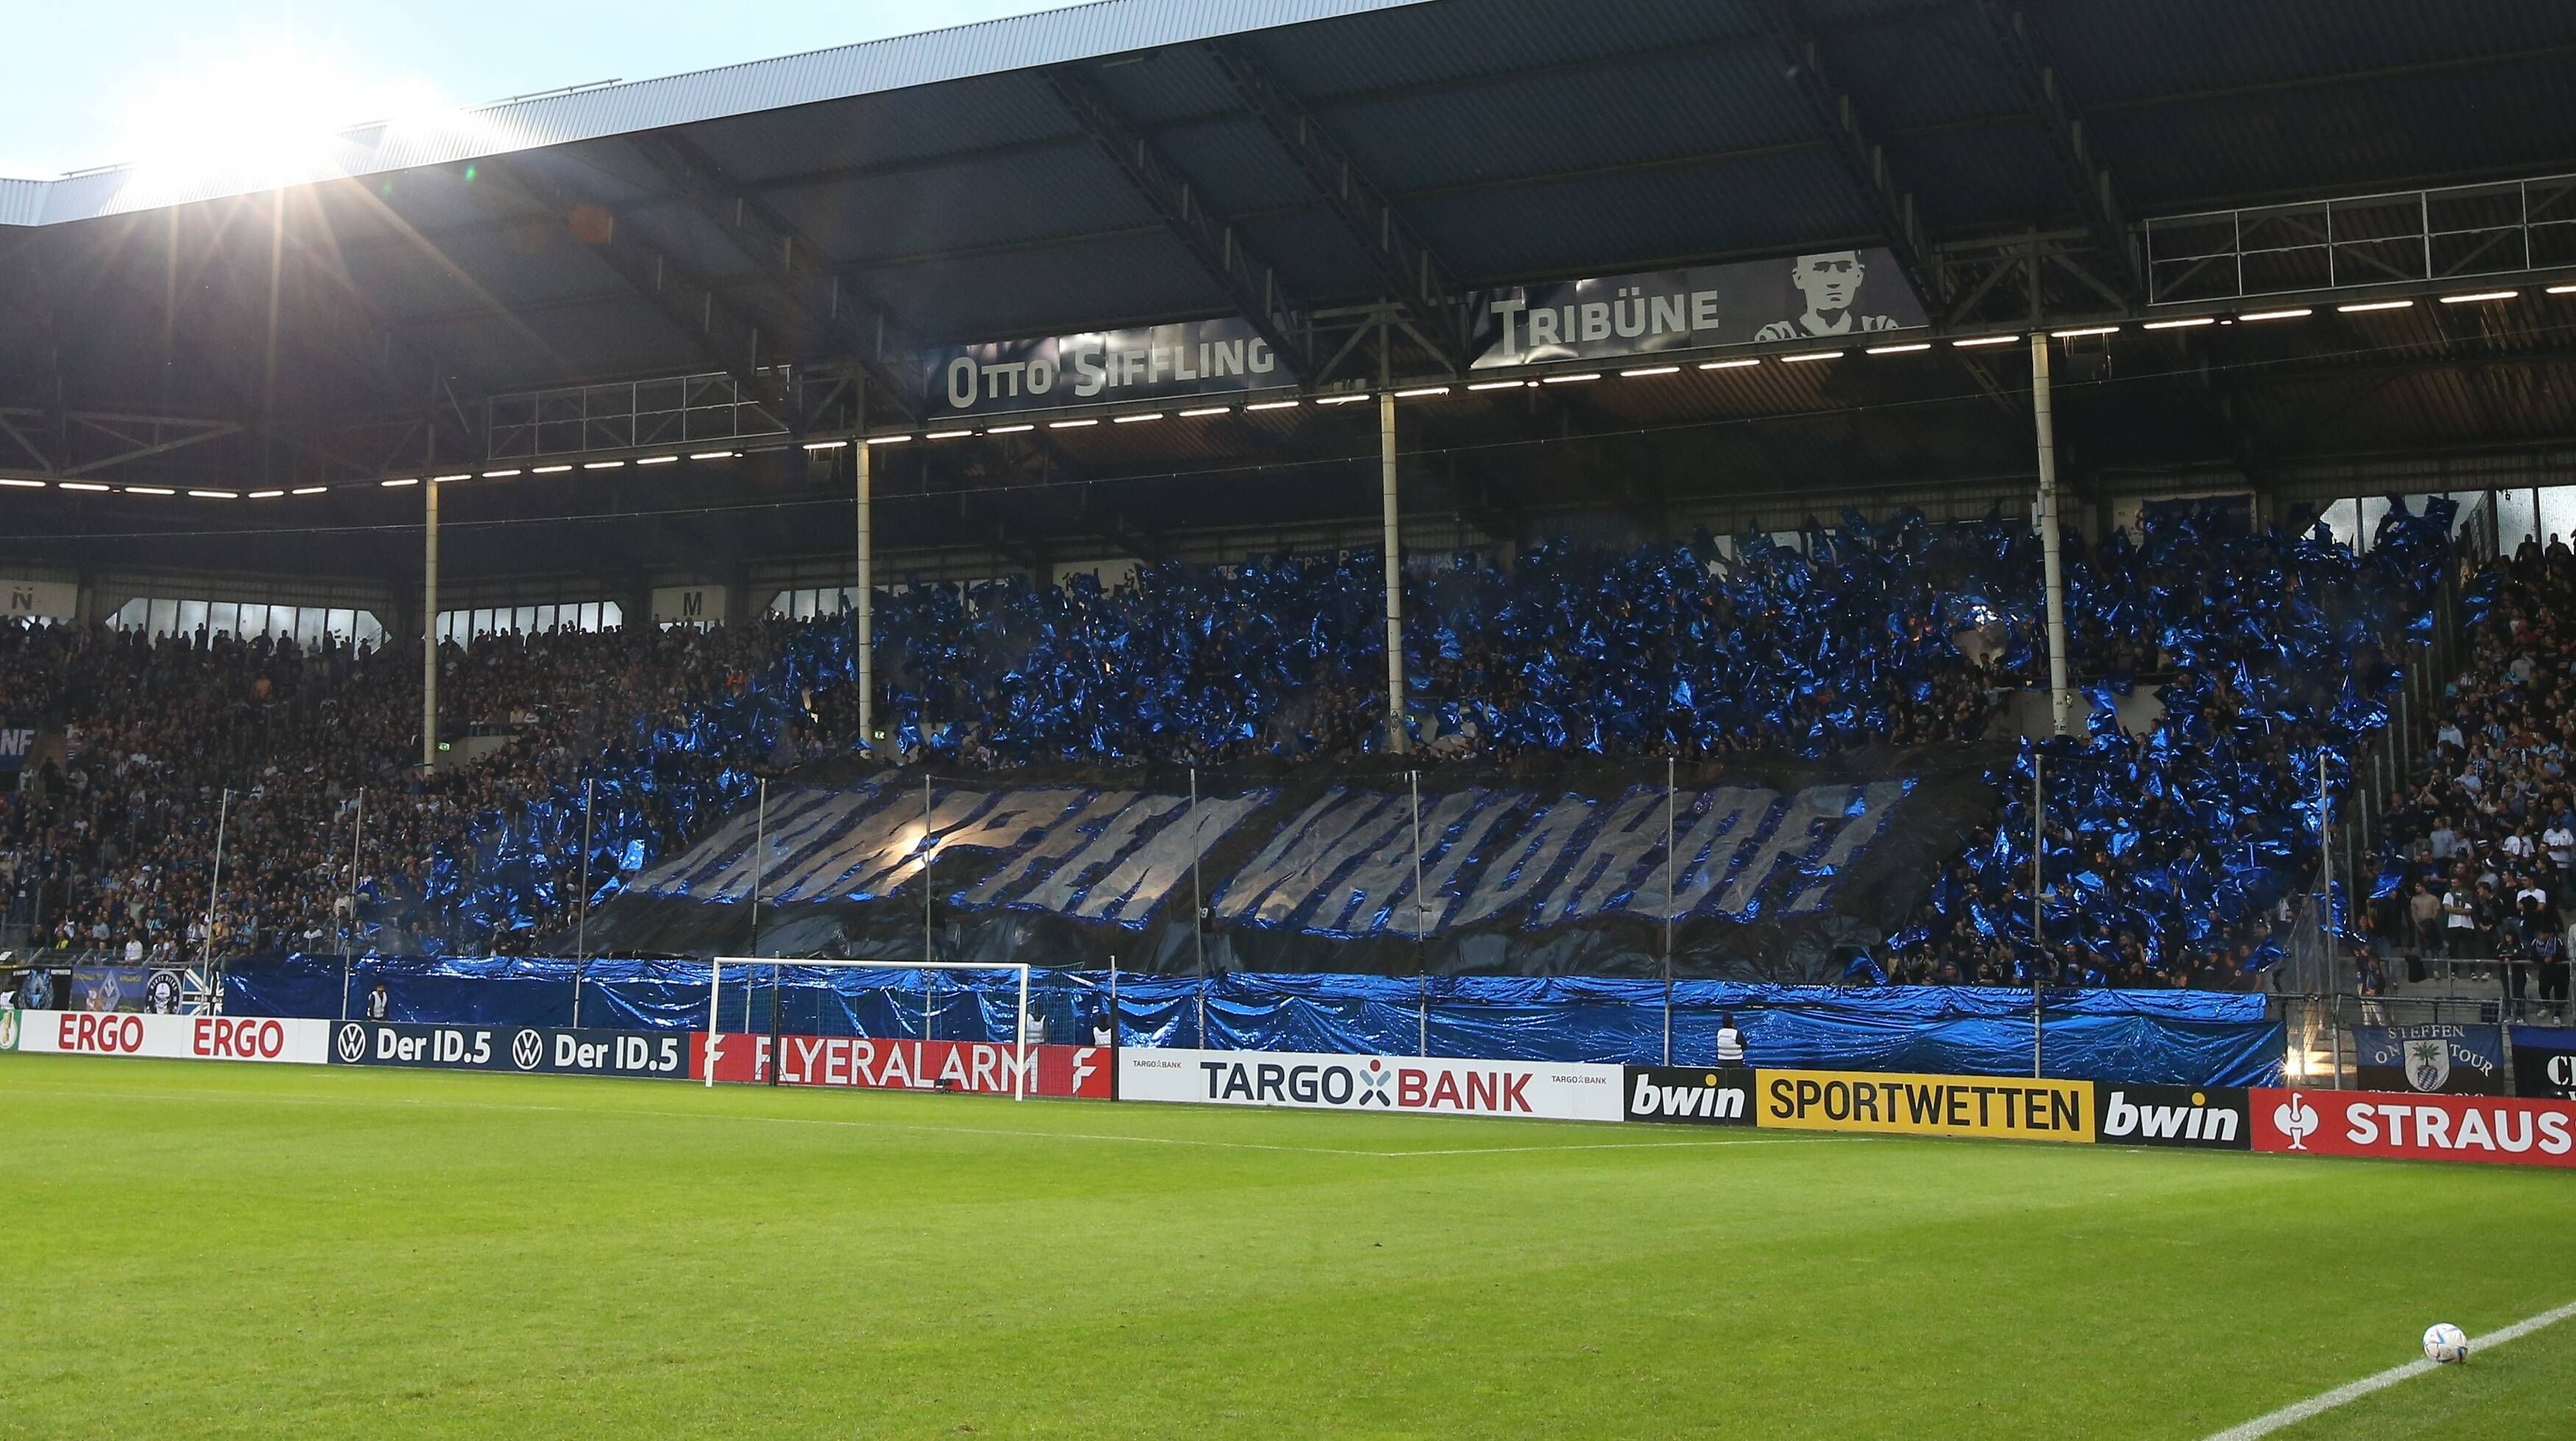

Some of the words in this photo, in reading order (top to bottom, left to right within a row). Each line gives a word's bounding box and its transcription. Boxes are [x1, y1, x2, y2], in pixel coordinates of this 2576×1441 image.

[684, 592, 701, 615] M
[59, 1014, 144, 1052] ERGO
[193, 1019, 283, 1058] ERGO
[377, 1028, 426, 1061] Der
[433, 1030, 490, 1063] ID.5
[2388, 1024, 2465, 1038] STEFFEN
[555, 1034, 608, 1068] Der
[615, 1036, 678, 1071] ID.5
[755, 1036, 1038, 1093] FLYERALARM
[2375, 1043, 2400, 1063] ON
[2450, 1044, 2493, 1077] TOUR
[1631, 1074, 1745, 1118] bwin
[1770, 1079, 2080, 1131] SPORTWETTEN
[2103, 1091, 2239, 1141] bwin
[2346, 1102, 2576, 1155] STRAUS
